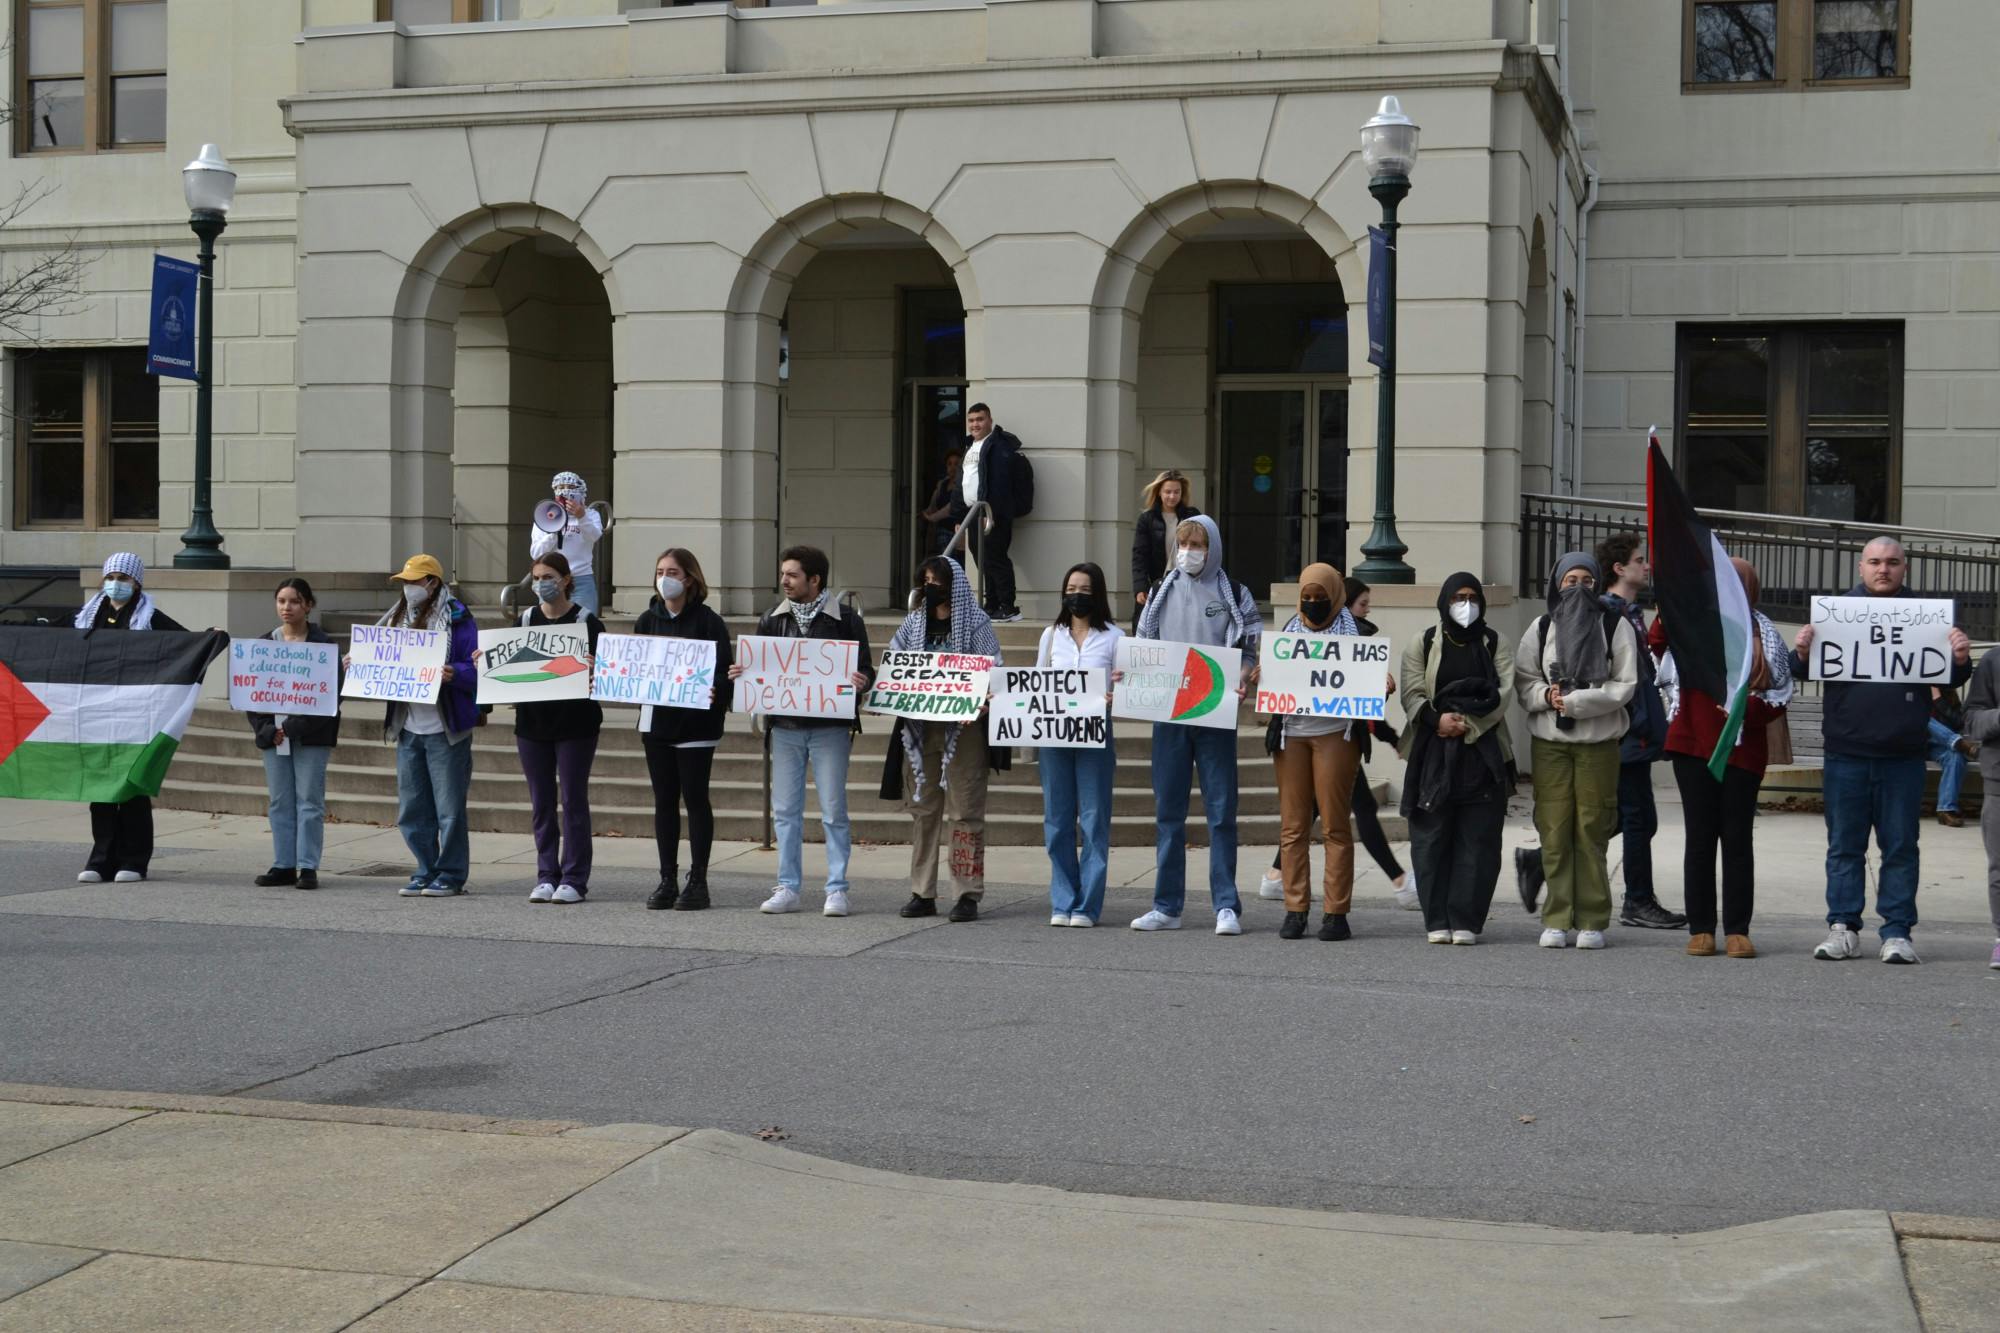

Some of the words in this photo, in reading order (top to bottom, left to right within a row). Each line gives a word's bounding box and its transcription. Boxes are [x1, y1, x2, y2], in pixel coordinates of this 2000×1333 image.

[353, 626, 438, 648] DIVESTMENT
[1870, 625, 1904, 645] BE
[234, 643, 245, 660] $
[318, 651, 328, 664] &
[374, 645, 402, 662] NOW
[484, 638, 522, 669] FREE
[526, 630, 589, 658] PALESTINE
[602, 638, 654, 661] DIVEST
[663, 640, 710, 668] FROM
[740, 639, 860, 679] DIVEST
[1273, 637, 1342, 660] GAZA
[1352, 643, 1388, 662] HAS
[1820, 640, 1946, 680] BLIND
[249, 660, 311, 678] education
[347, 663, 396, 681] PROTECT
[396, 666, 416, 681] ALL
[419, 667, 436, 682] AU
[629, 662, 674, 681] DEATH
[882, 652, 933, 667] RESIST
[937, 653, 993, 672] OPPRESSION
[233, 675, 258, 687] NOT
[319, 682, 329, 694] &
[891, 669, 972, 682] CREATE
[1006, 669, 1088, 695] PROTECT
[1310, 670, 1345, 689] NO
[363, 680, 431, 698] STUDENTS
[594, 674, 643, 699] INVEST
[647, 680, 664, 701] IN
[667, 682, 700, 704] LIFE
[744, 680, 838, 713] Death
[876, 681, 973, 693] COLLECTIVE
[868, 691, 981, 715] LIBERATION
[1027, 695, 1066, 715] ALL
[1257, 690, 1297, 714] FOOD
[1312, 696, 1384, 717] WATER
[996, 717, 1022, 740] AU
[1031, 715, 1106, 744] STUDENTS
